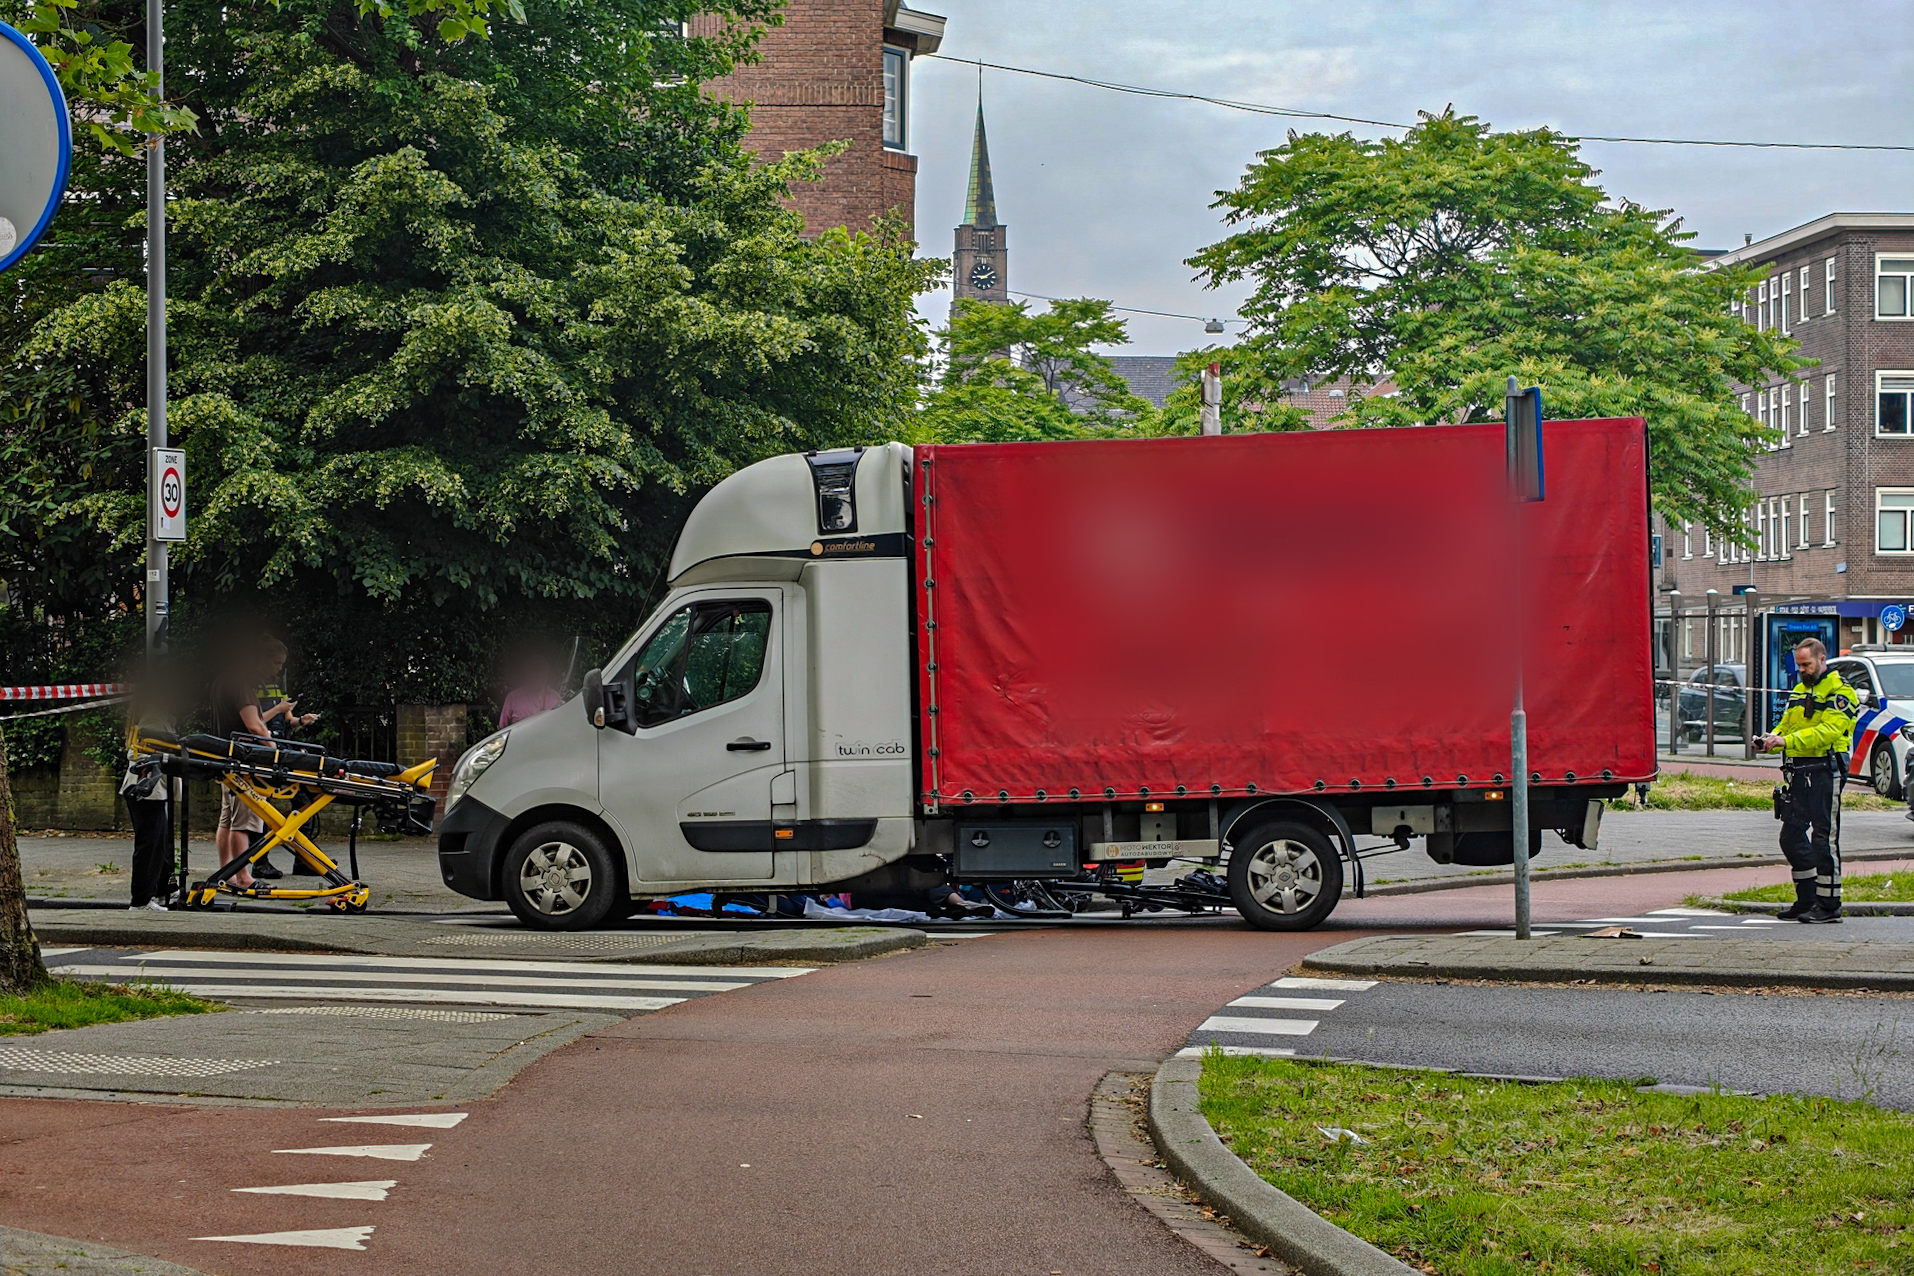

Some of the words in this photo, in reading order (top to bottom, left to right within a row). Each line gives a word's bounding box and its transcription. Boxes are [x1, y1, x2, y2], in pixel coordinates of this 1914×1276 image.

[165, 455, 178, 464] ZONE
[165, 483, 178, 502] 30
[824, 541, 876, 552] comfortline
[839, 744, 870, 756] twin
[876, 742, 905, 755] cab
